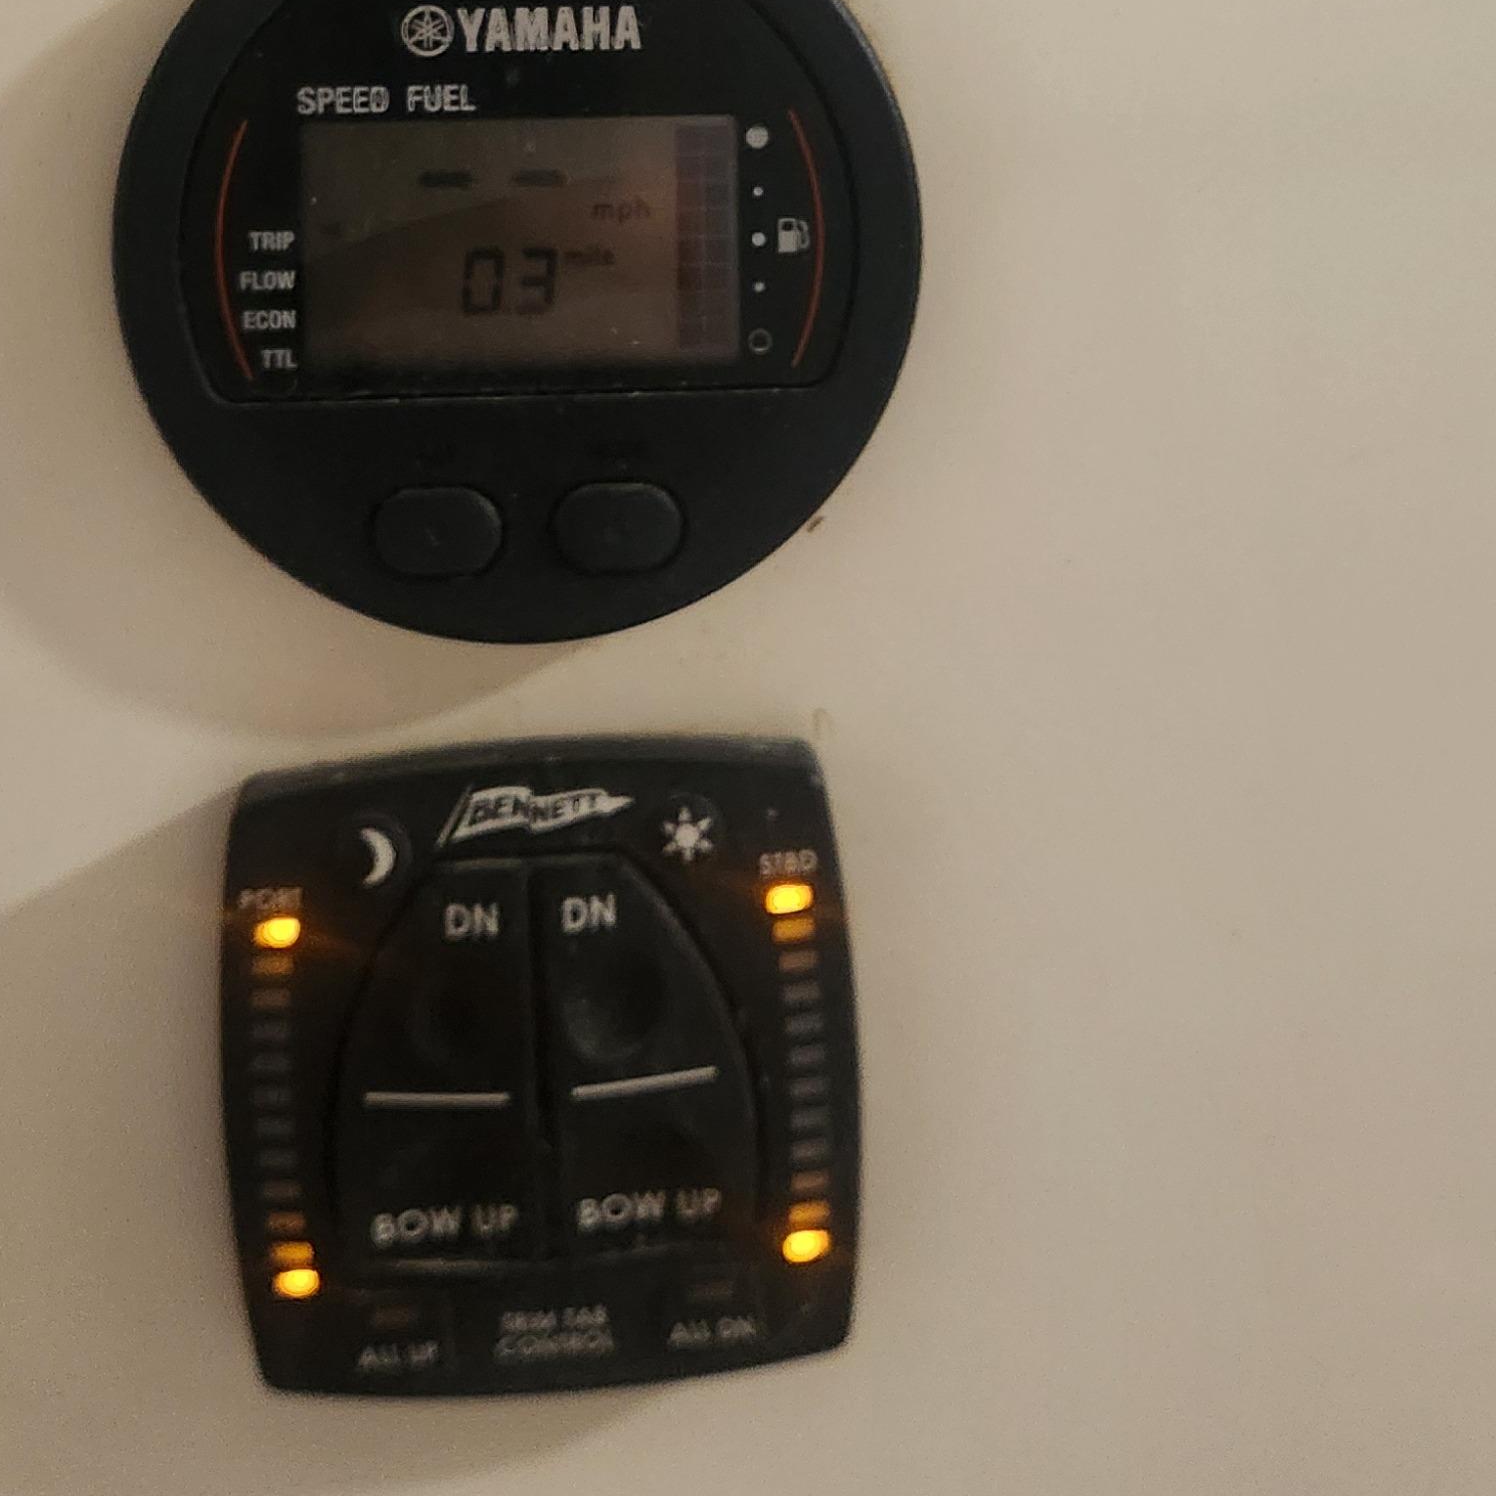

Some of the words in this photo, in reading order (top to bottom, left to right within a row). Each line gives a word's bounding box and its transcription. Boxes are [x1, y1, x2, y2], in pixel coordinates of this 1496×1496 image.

[456, 5, 642, 53] YAMAHA
[296, 84, 390, 116] SPEED
[406, 83, 477, 113] FUEL
[591, 199, 651, 223] mph
[248, 230, 295, 252] TRIP
[239, 270, 296, 292] FLOW
[242, 309, 297, 331] ECON
[261, 348, 298, 370] TTL
[443, 902, 500, 941] DN
[561, 892, 617, 933] DN
[370, 1203, 461, 1248] BOW
[469, 1202, 520, 1237] UP
[576, 1189, 667, 1235] BOW
[676, 1186, 723, 1221] UP
